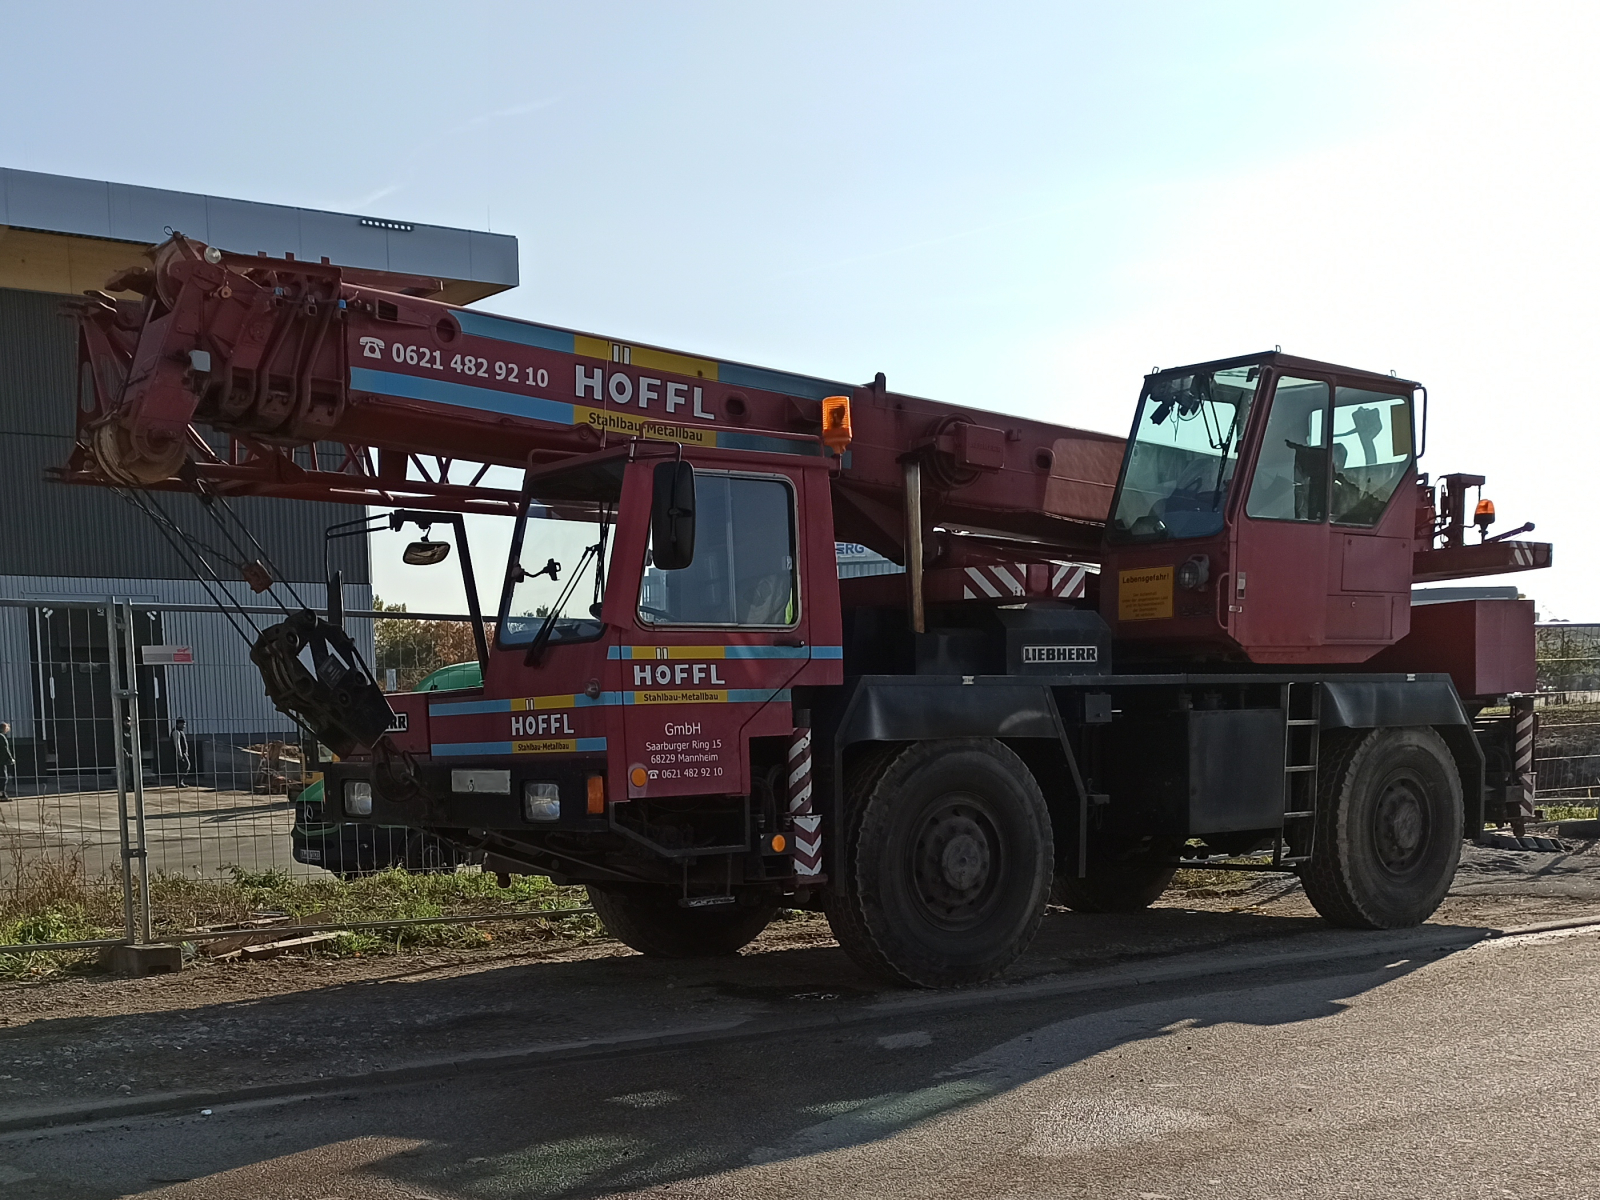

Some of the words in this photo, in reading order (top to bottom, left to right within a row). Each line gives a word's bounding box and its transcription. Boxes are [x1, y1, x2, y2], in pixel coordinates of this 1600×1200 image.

[392, 342, 443, 370] 0621
[450, 353, 489, 378] 482
[494, 361, 519, 383] 92
[525, 366, 549, 388] 10
[588, 411, 703, 442] Stahlbau-Metallbau
[1122, 572, 1170, 585] Lebensgefahr!
[1024, 647, 1097, 662] LIEBHERR
[643, 692, 719, 702] Stahlbau-Metallbau
[664, 722, 701, 736] GmbH
[518, 743, 570, 752] Stahlbau-Metallbau
[646, 741, 690, 753] Saarburger
[692, 740, 710, 752] Ring
[712, 739, 722, 749] 15
[651, 754, 676, 764] 68229
[678, 753, 719, 764] Mannheim
[661, 769, 682, 779] 0621
[683, 768, 698, 778] 482
[700, 768, 711, 777] 92
[713, 767, 723, 777] 10
